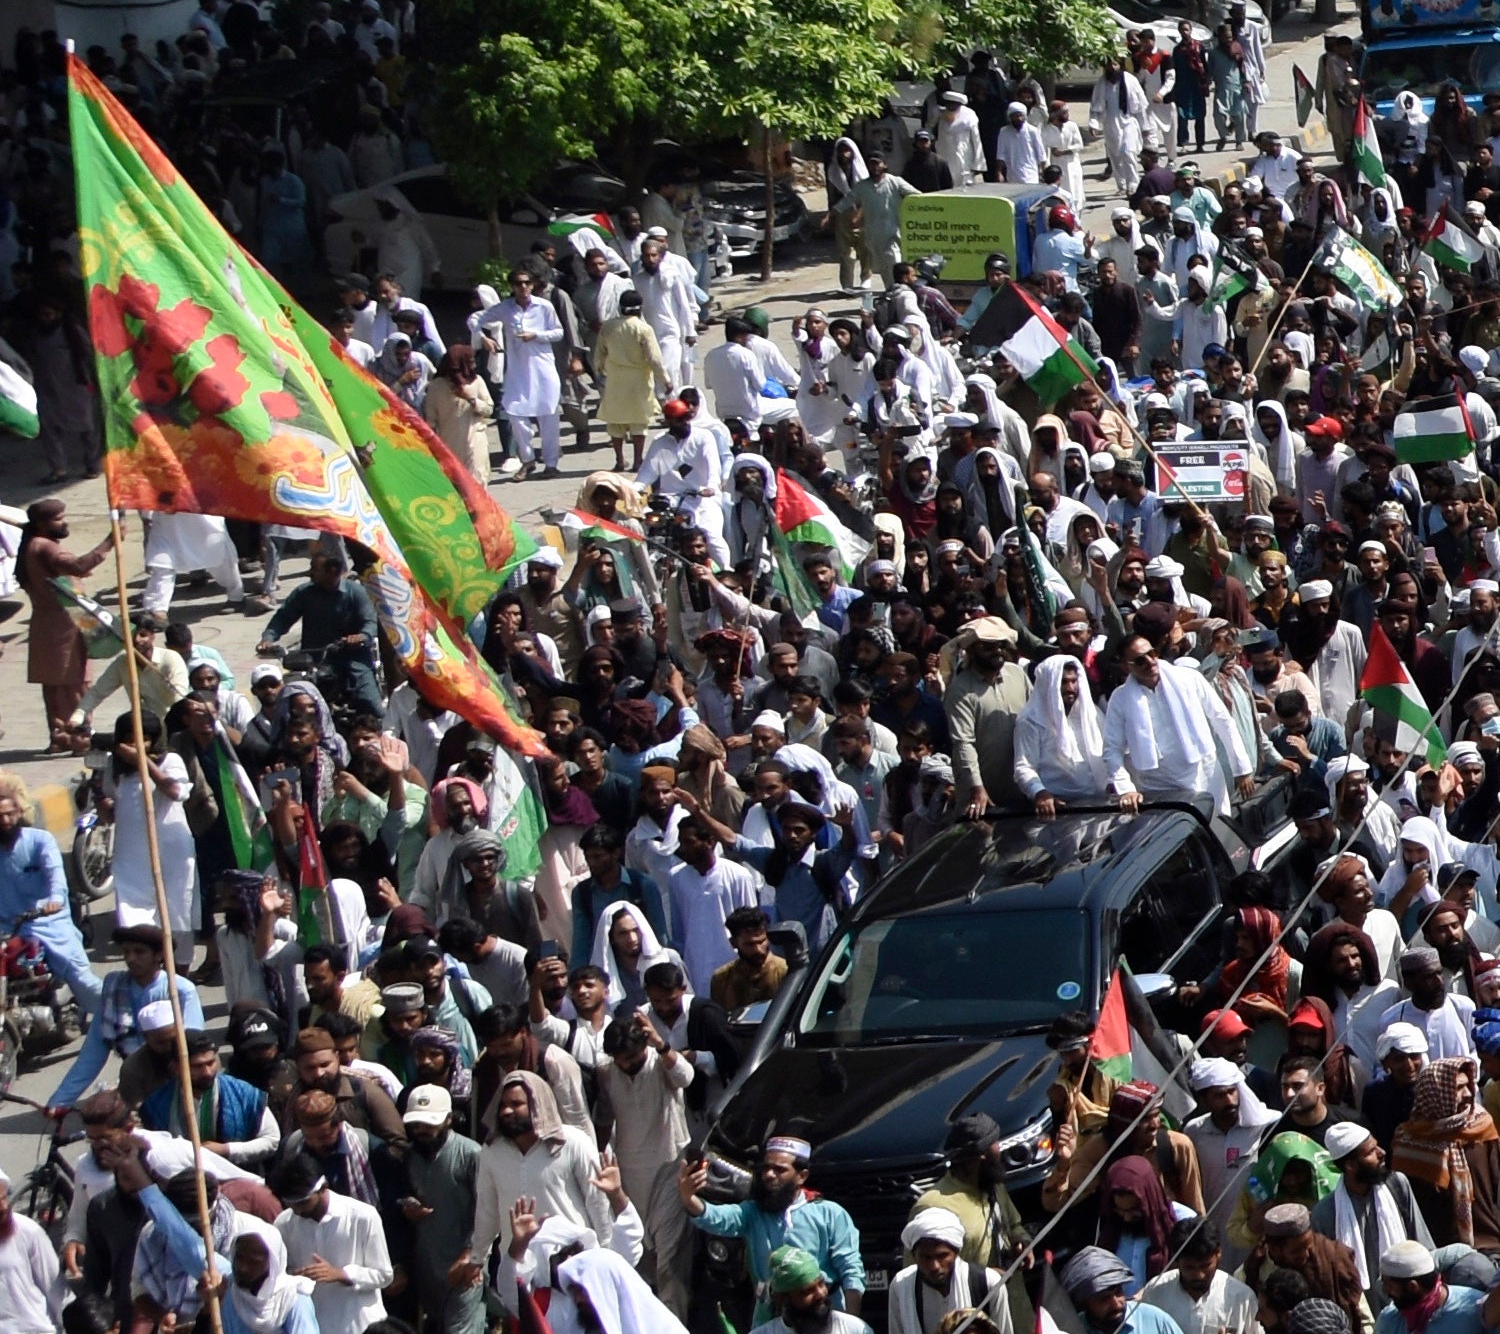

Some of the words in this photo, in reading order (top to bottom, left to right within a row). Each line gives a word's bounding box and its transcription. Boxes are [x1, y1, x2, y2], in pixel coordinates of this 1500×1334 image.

[906, 220, 932, 230] Chal
[935, 220, 949, 230] Dil
[908, 231, 932, 242] chor
[935, 231, 949, 242] de
[951, 234, 965, 244] ye
[967, 233, 1000, 244] phere
[1180, 456, 1205, 465] FREE
[1173, 484, 1215, 492] PLESTINE
